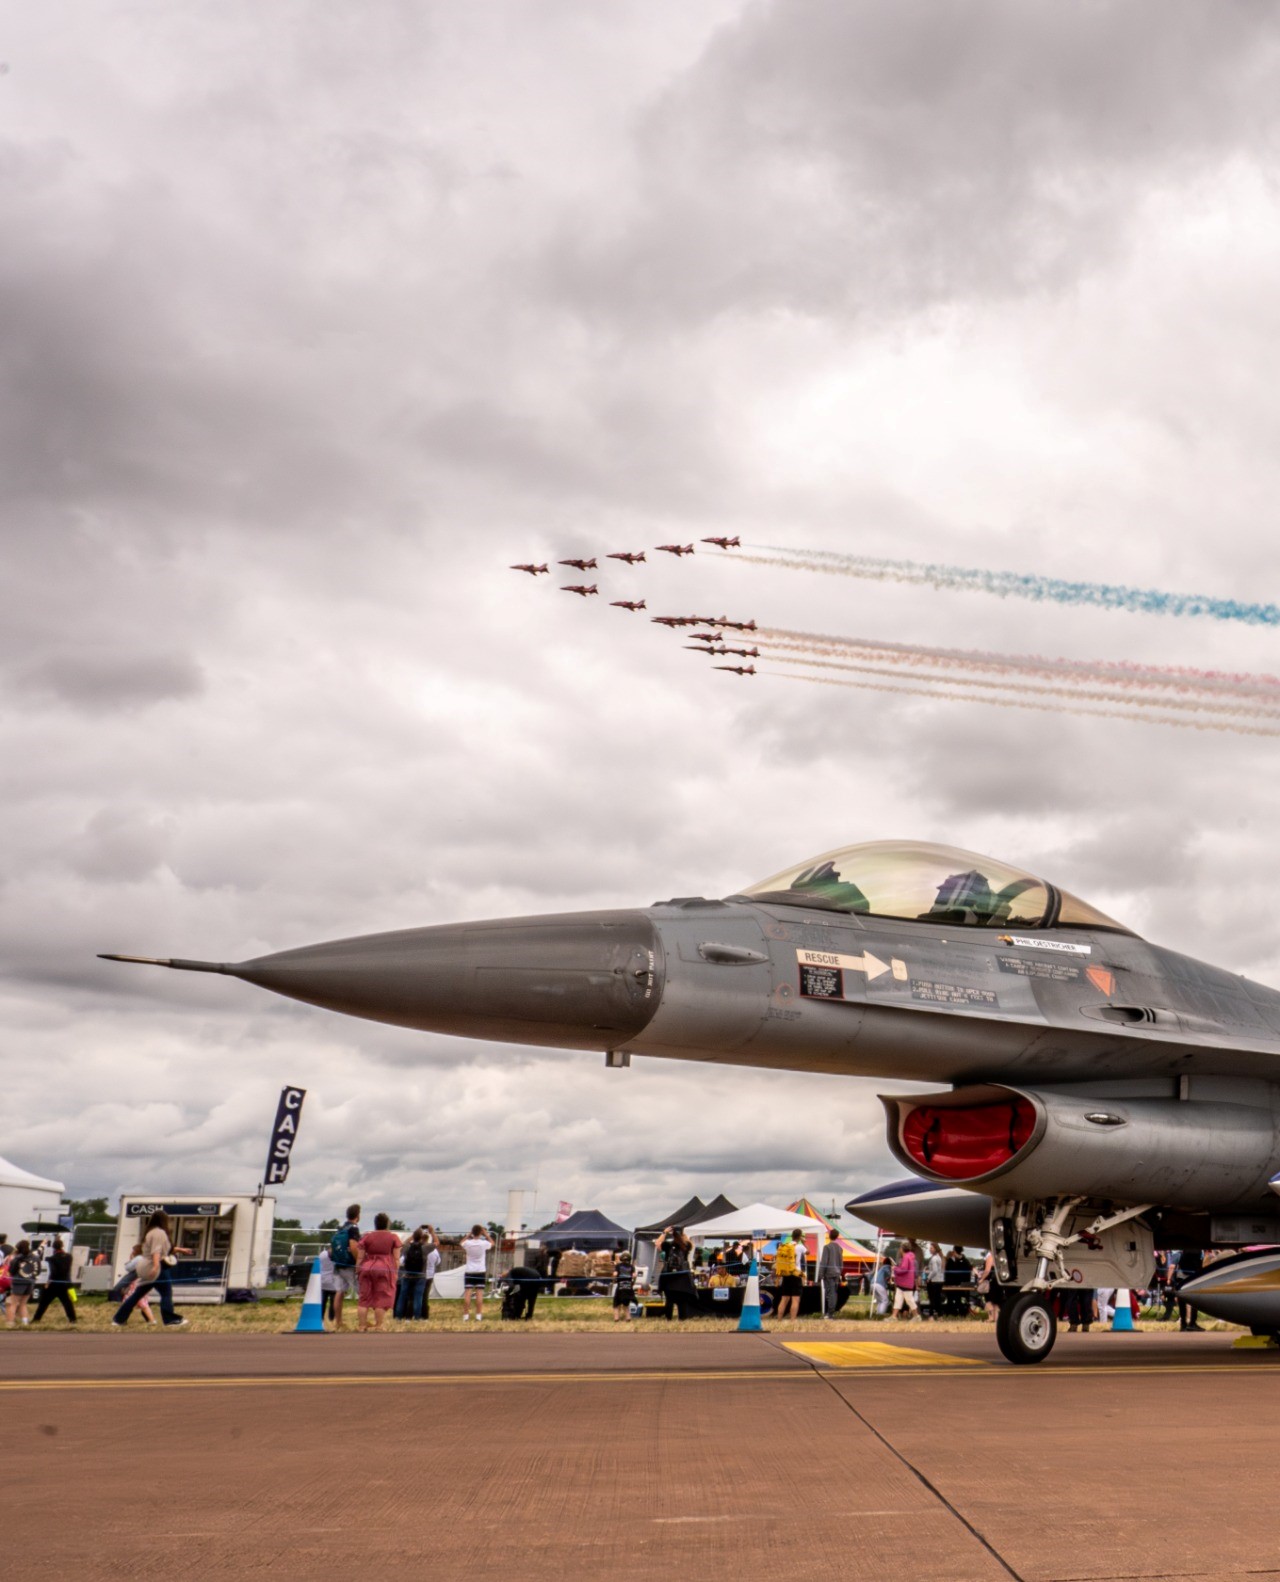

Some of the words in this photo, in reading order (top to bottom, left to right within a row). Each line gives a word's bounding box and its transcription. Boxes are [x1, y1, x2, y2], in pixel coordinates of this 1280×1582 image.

[1015, 938, 1032, 946] PHIL
[804, 952, 840, 966] RESCUE
[269, 1091, 301, 1182] CASH
[130, 1204, 164, 1215] CASH
